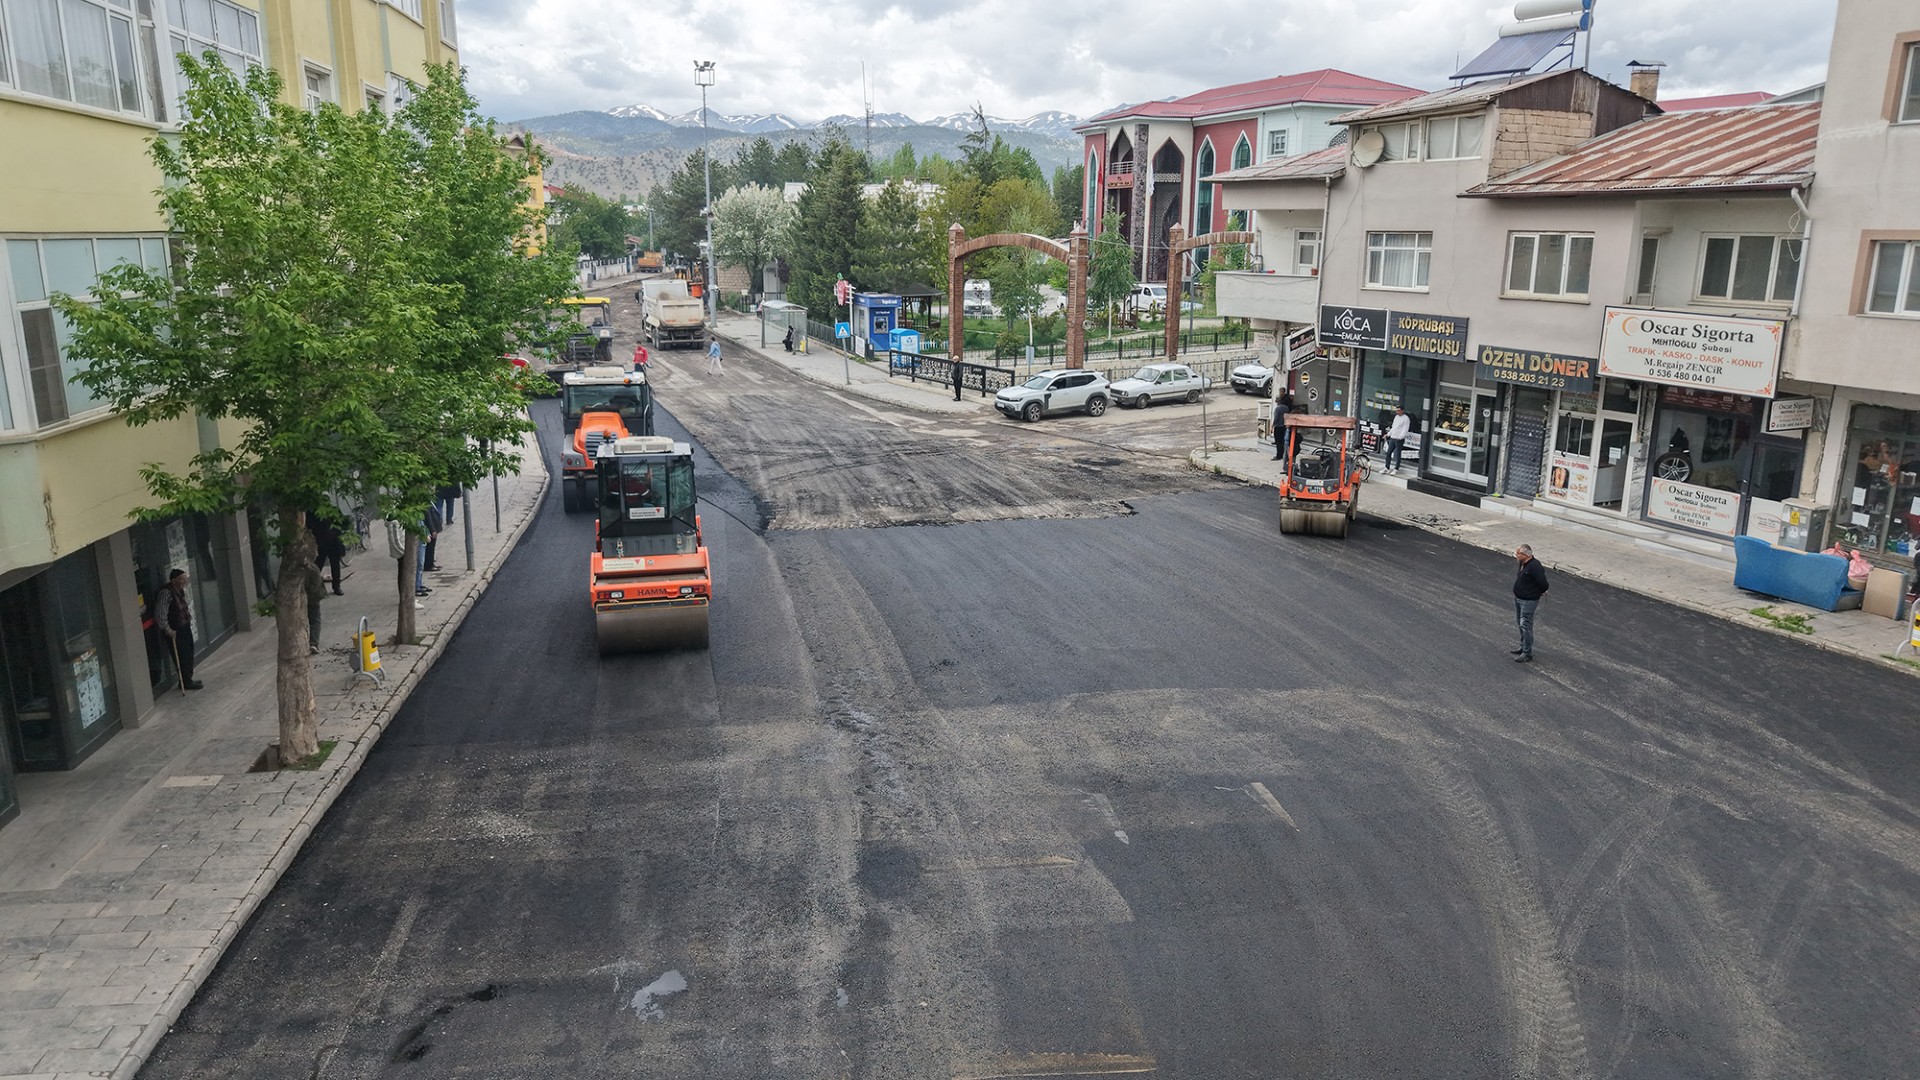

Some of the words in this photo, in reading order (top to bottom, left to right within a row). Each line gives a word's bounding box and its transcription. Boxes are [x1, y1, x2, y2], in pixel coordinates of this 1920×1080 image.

[1334, 314, 1371, 332] KOCA
[1398, 316, 1455, 336] KÖPRÜBAŞI
[1641, 319, 1688, 336] Oscar
[1692, 324, 1754, 343] Sigorta
[1342, 332, 1362, 341] EMLAK
[1392, 334, 1460, 356] KUYUMCUSU
[1702, 343, 1732, 353] Şubesi
[1482, 346, 1526, 370] ÖZEN
[1529, 354, 1589, 378] DÖNER
[1662, 350, 1692, 360] KASKO
[1700, 354, 1724, 364] DASK
[1732, 358, 1764, 368] KONUT
[1494, 369, 1500, 378] 0
[1501, 370, 1517, 380] 538
[1519, 373, 1535, 382] 203
[1538, 376, 1548, 385] 21
[1552, 377, 1565, 387] 23
[1657, 370, 1671, 378] 536
[1674, 371, 1690, 380] 480
[1692, 374, 1702, 382] 04
[1706, 376, 1715, 384] 01
[1668, 486, 1693, 497] Oscar
[1695, 490, 1727, 505] Sigorta
[638, 588, 667, 596] HAMM
